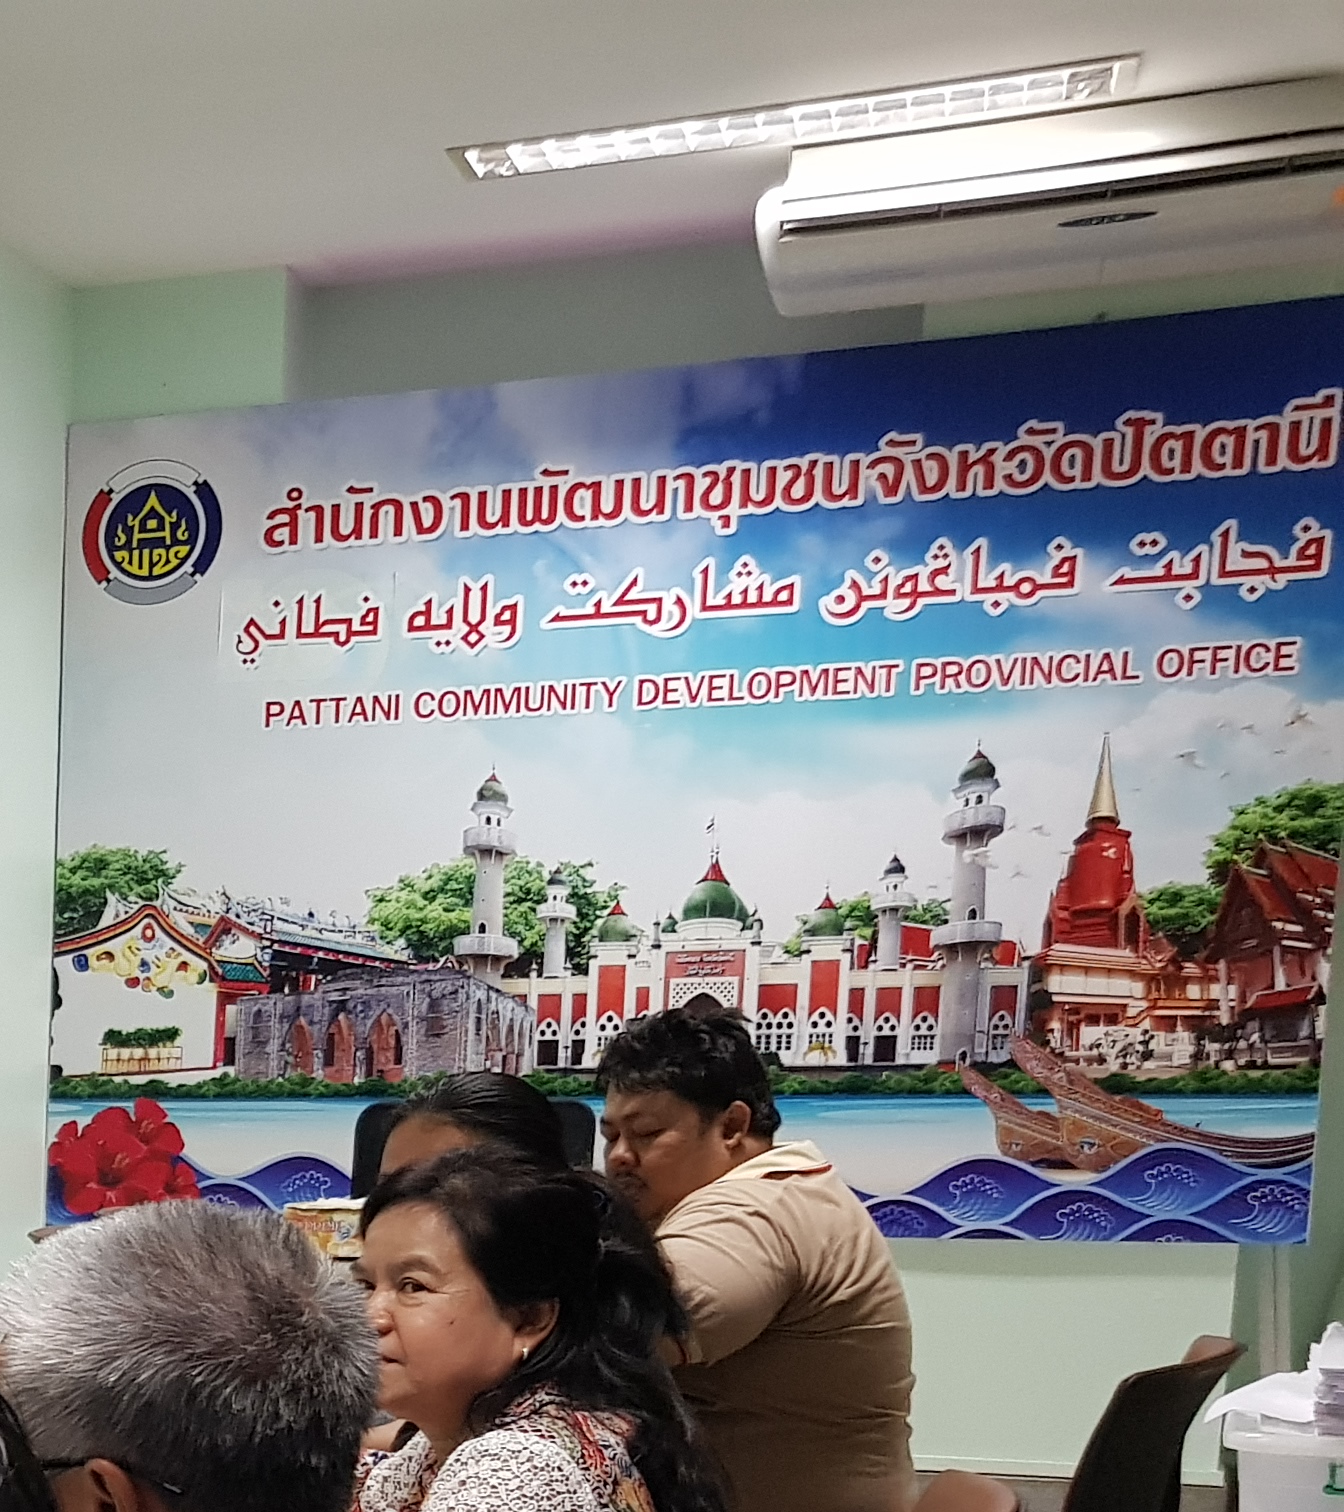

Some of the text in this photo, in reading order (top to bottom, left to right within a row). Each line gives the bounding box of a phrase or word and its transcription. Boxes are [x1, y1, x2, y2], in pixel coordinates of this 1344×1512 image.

[262, 394, 1338, 549] สำนักงานพัฒนาชุมชนจังหวัดปัตตานี
[264, 640, 1300, 729] PATTANI COMMUNITY DEVELOPMENT PROVINCIAL OFFICE
